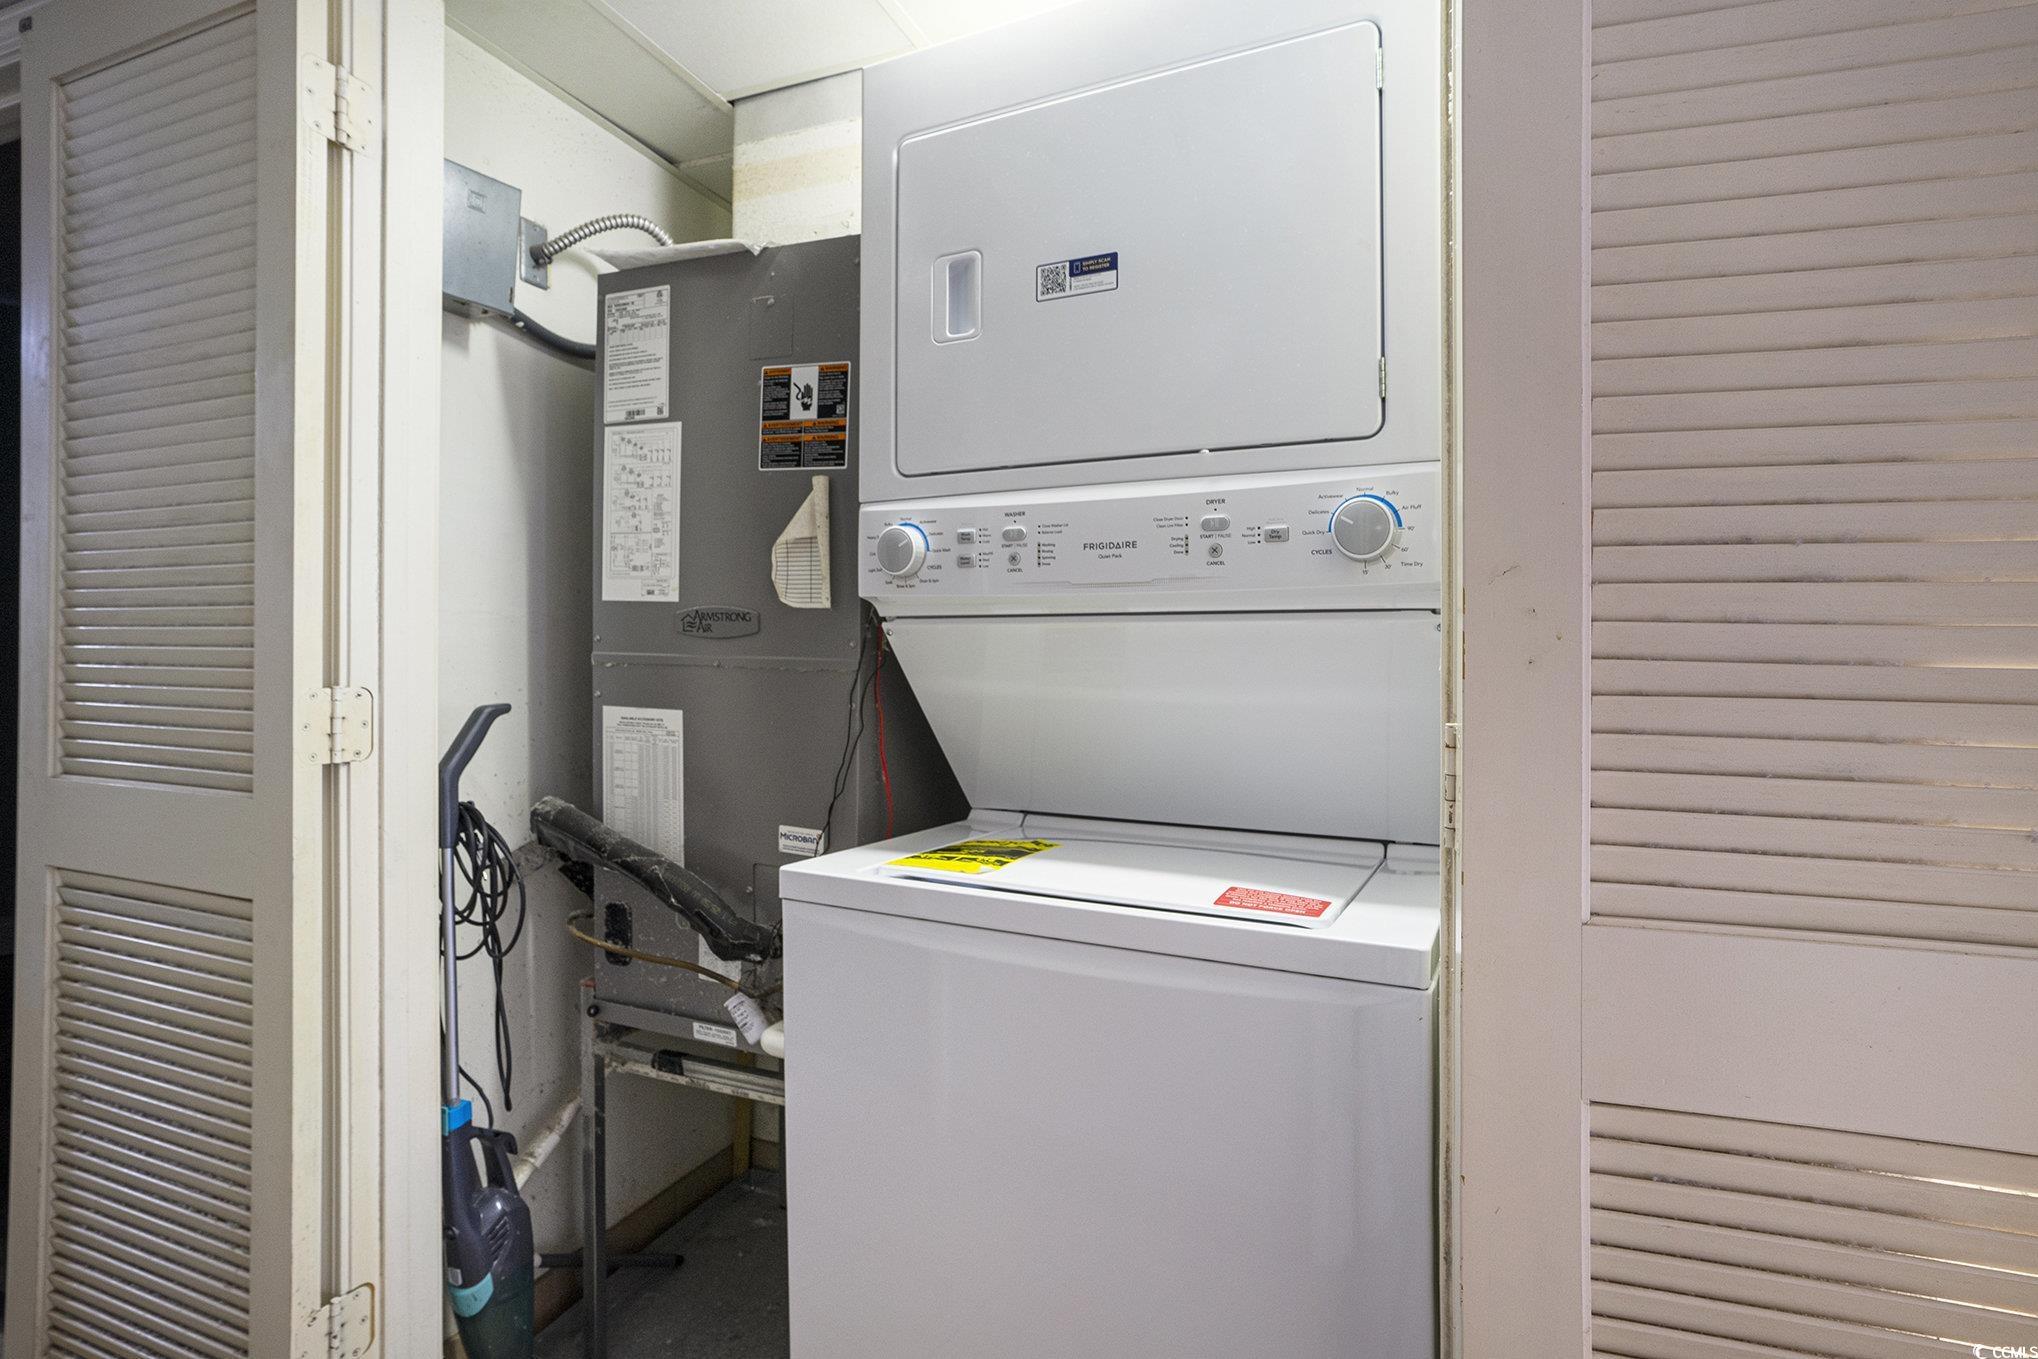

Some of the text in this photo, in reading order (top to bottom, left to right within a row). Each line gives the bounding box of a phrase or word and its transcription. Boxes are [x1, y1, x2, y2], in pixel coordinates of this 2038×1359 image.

[1083, 541, 1138, 550] FRIGIDAIRE
[694, 610, 752, 622] ARMSTRONG
[696, 620, 713, 632] AIR
